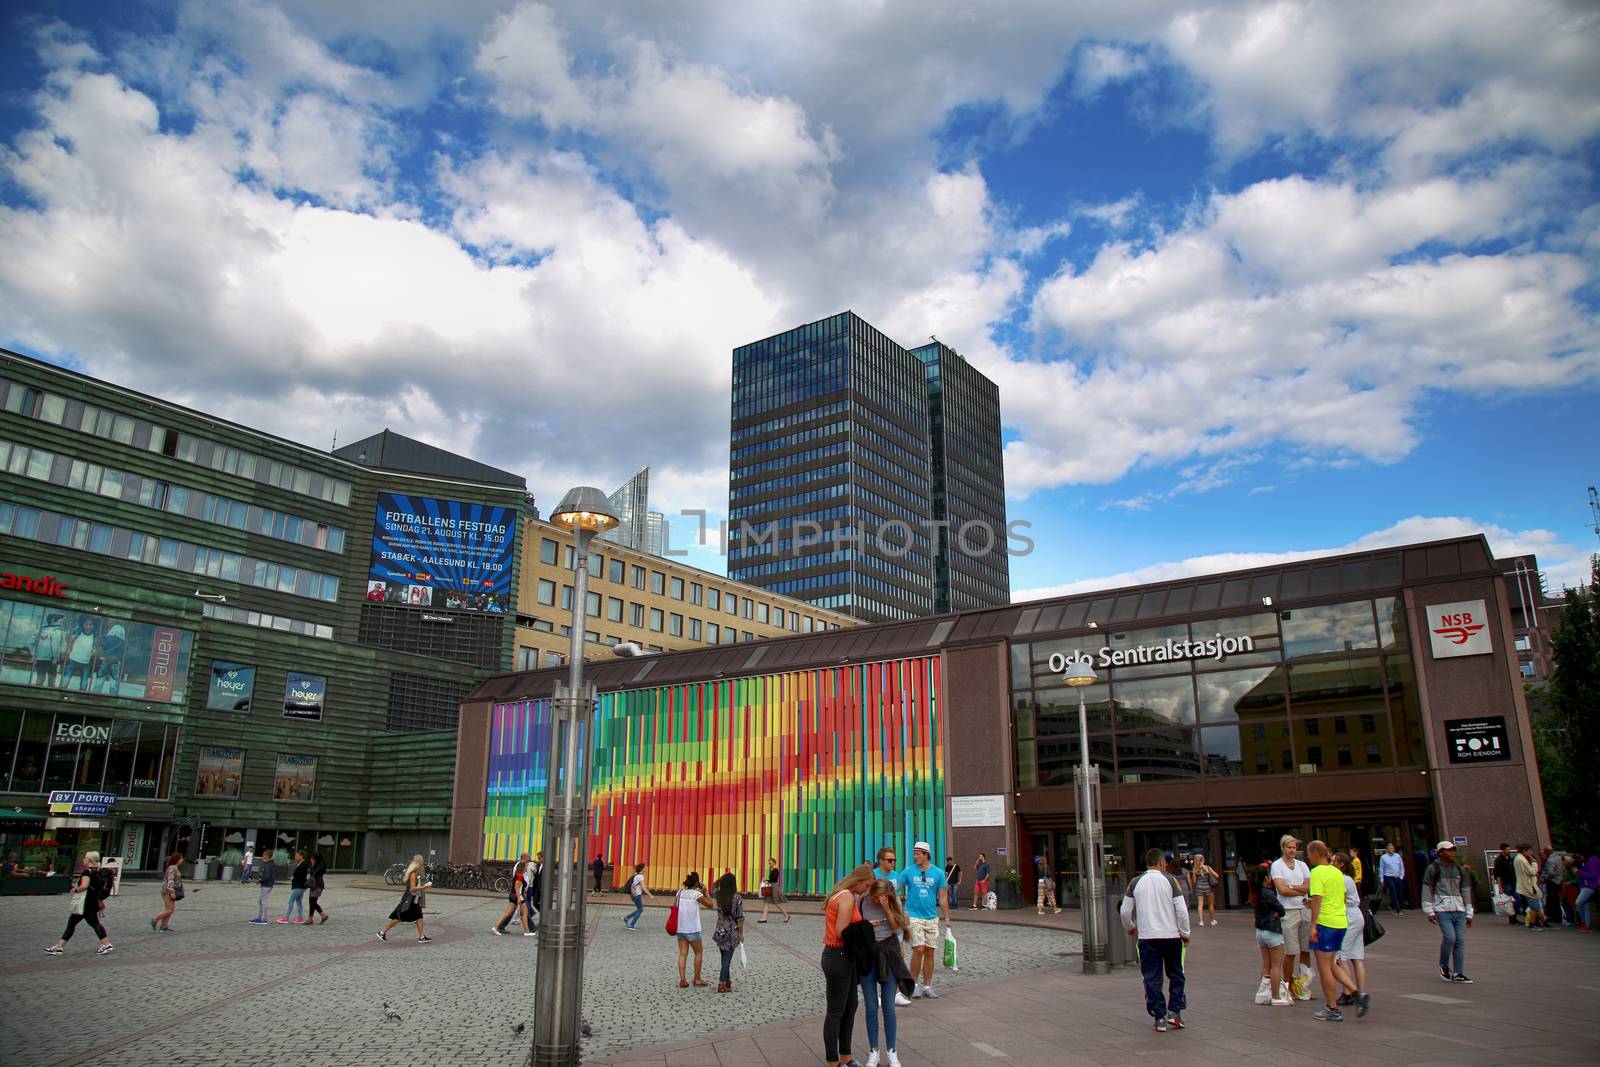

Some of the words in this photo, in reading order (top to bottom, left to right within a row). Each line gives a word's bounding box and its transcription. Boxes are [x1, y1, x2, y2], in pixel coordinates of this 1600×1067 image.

[385, 522, 420, 534] SØNDAG
[421, 526, 433, 535] 21.
[434, 528, 467, 539] AUGUST
[469, 532, 482, 541] KL.
[483, 534, 505, 544] 15.00
[386, 511, 456, 528] FOTBALLENS
[458, 520, 506, 534] FESTDAG
[381, 551, 416, 562] STABÆK
[422, 556, 466, 568] AALESUND
[467, 561, 480, 569] KL.
[481, 562, 503, 571] 18.00
[1441, 613, 1473, 627] NSB
[154, 631, 174, 676] name
[1048, 650, 1093, 673] Oslo
[1099, 632, 1254, 668] Sentralstasjon
[151, 682, 169, 692] it
[57, 722, 110, 740] EGON
[124, 825, 138, 865] Scandic
